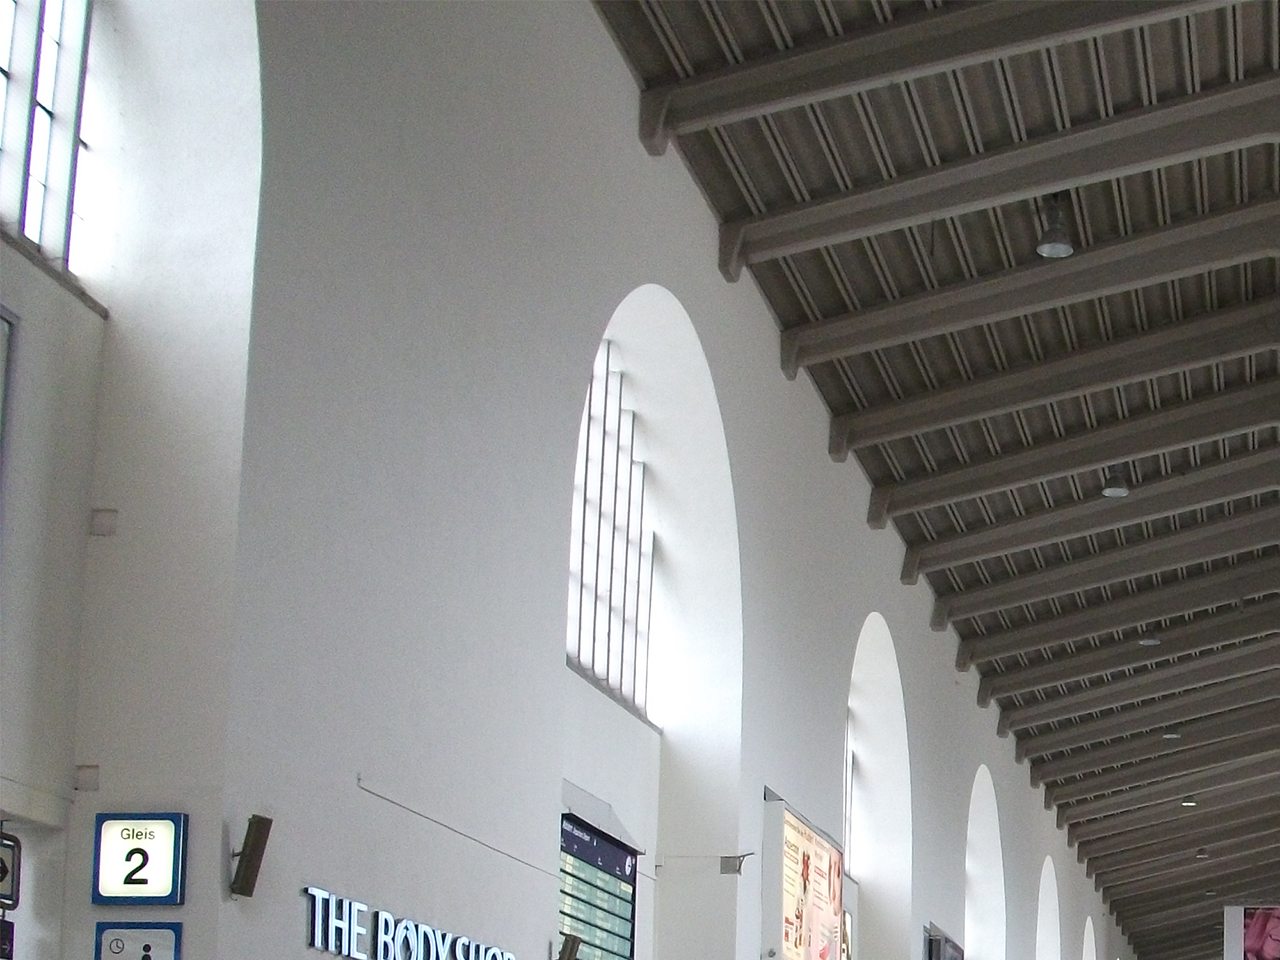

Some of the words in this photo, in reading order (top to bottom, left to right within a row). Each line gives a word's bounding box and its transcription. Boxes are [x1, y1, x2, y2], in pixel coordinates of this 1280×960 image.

[120, 828, 155, 840] Gleis
[123, 848, 149, 885] 2
[307, 886, 367, 960] THE
